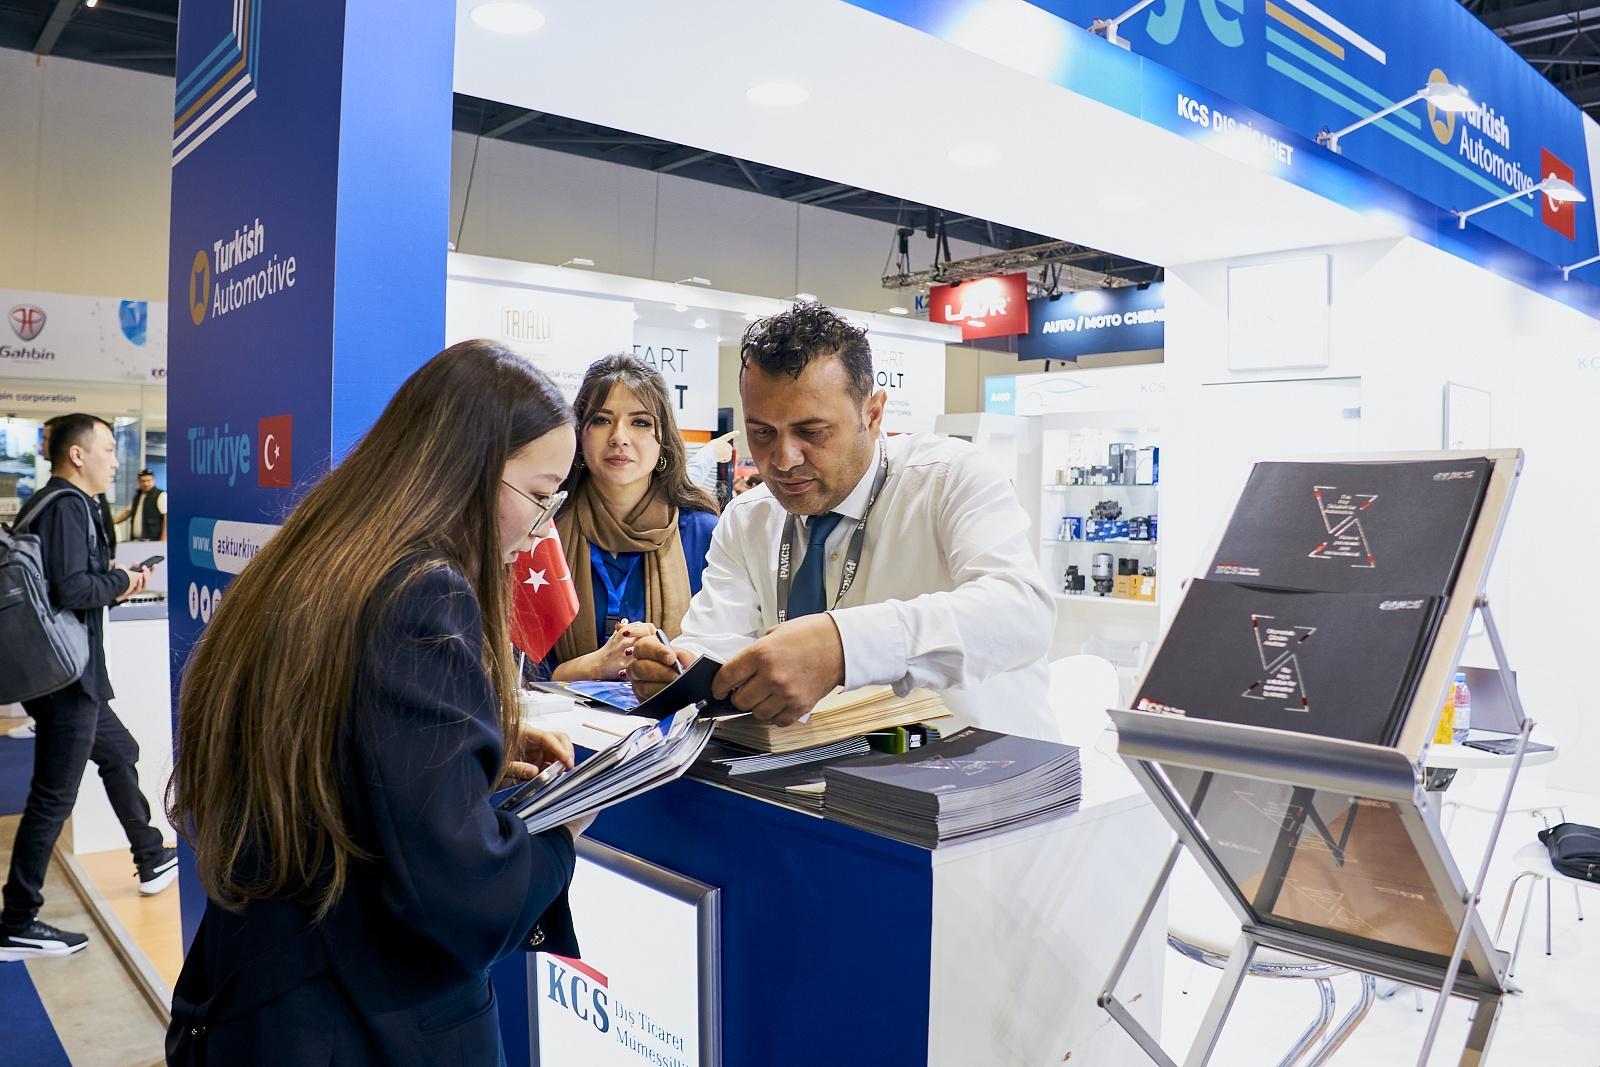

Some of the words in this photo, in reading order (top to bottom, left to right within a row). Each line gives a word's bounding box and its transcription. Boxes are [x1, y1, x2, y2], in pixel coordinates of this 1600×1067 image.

[1177, 93, 1210, 128] KCS
[1461, 102, 1510, 150] urkish
[1459, 125, 1534, 200] Automotive
[213, 218, 265, 275] Turkish
[212, 254, 297, 318] Automotive
[1042, 318, 1076, 334] AUTO
[1085, 314, 1122, 330] MOTO
[0, 345, 55, 361] Gahbin
[16, 393, 77, 404] corporation
[188, 423, 251, 487] Türkiye
[547, 960, 609, 1034] KCS
[638, 1011, 684, 1054] Ticaret
